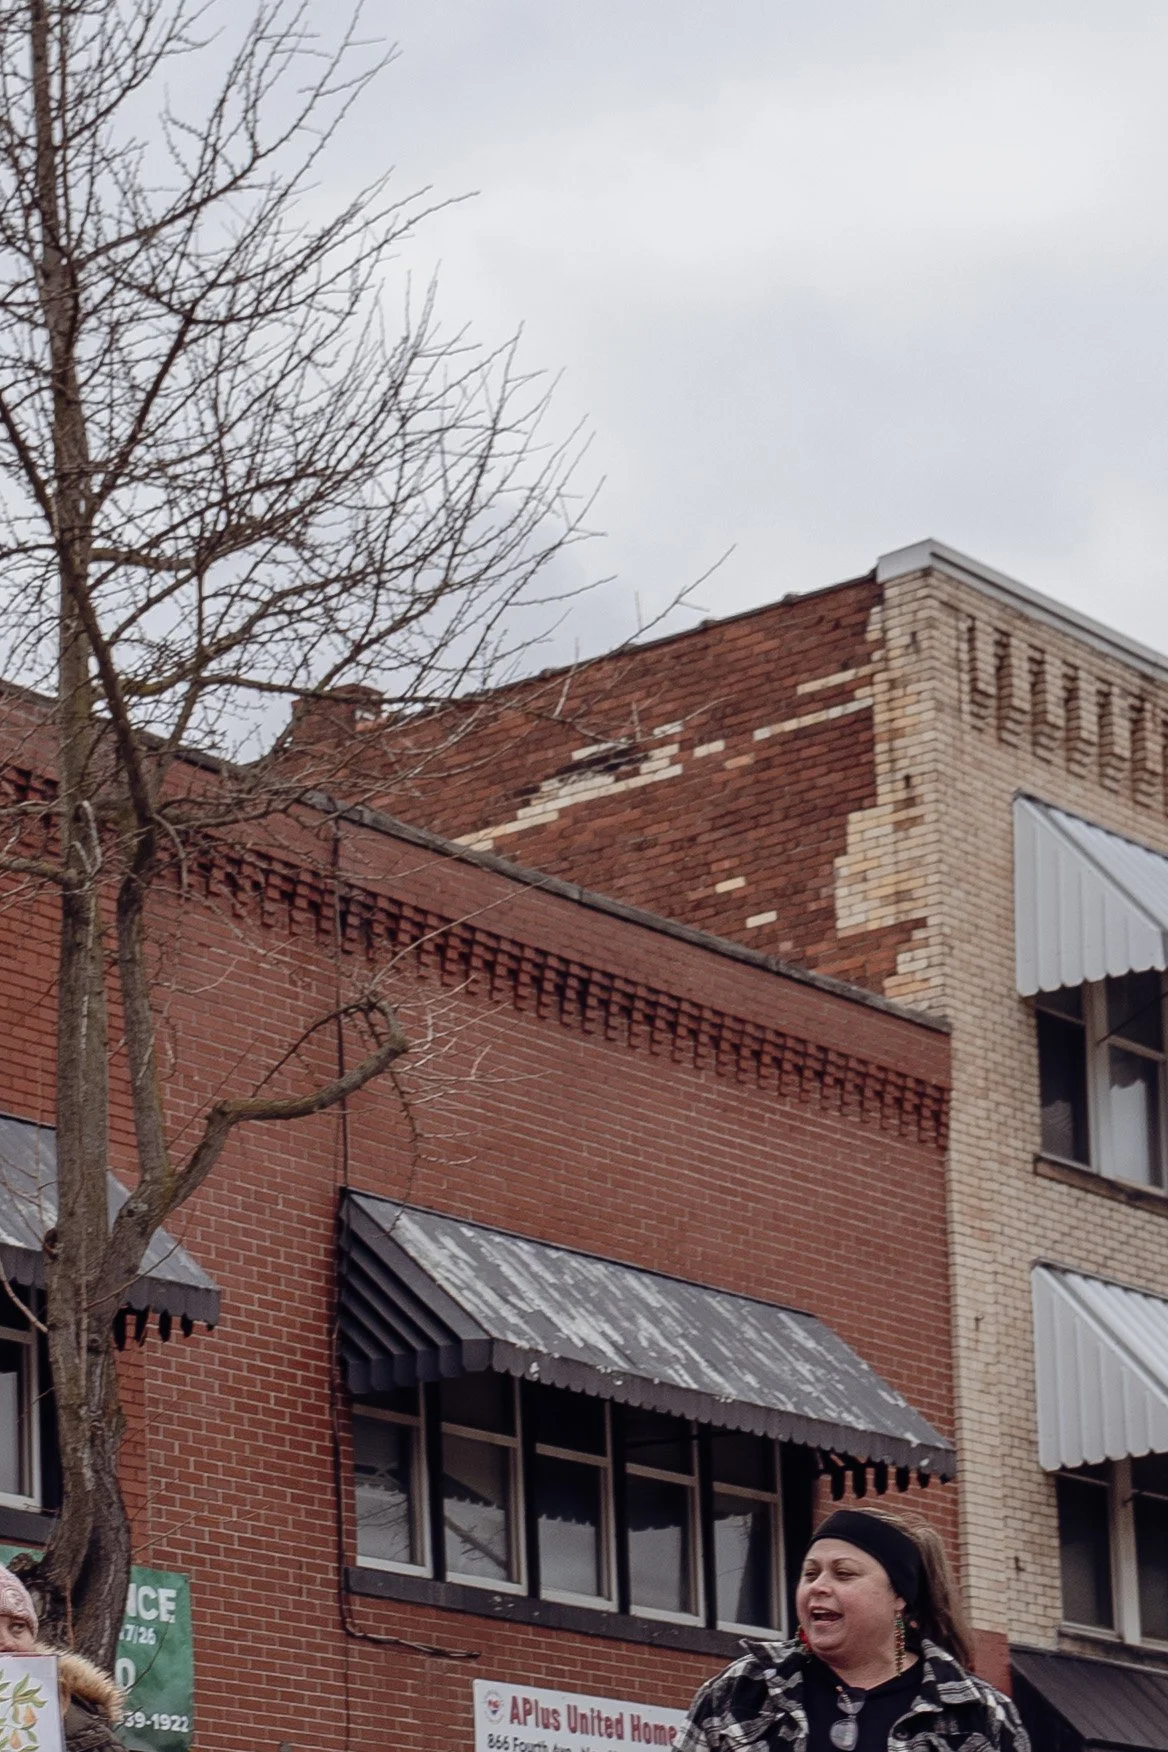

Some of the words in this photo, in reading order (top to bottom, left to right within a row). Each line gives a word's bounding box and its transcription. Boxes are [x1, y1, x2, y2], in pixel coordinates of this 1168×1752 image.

[510, 1696, 561, 1731] APlus
[567, 1703, 624, 1741] United
[631, 1714, 677, 1746] Home
[487, 1733, 510, 1751] 866
